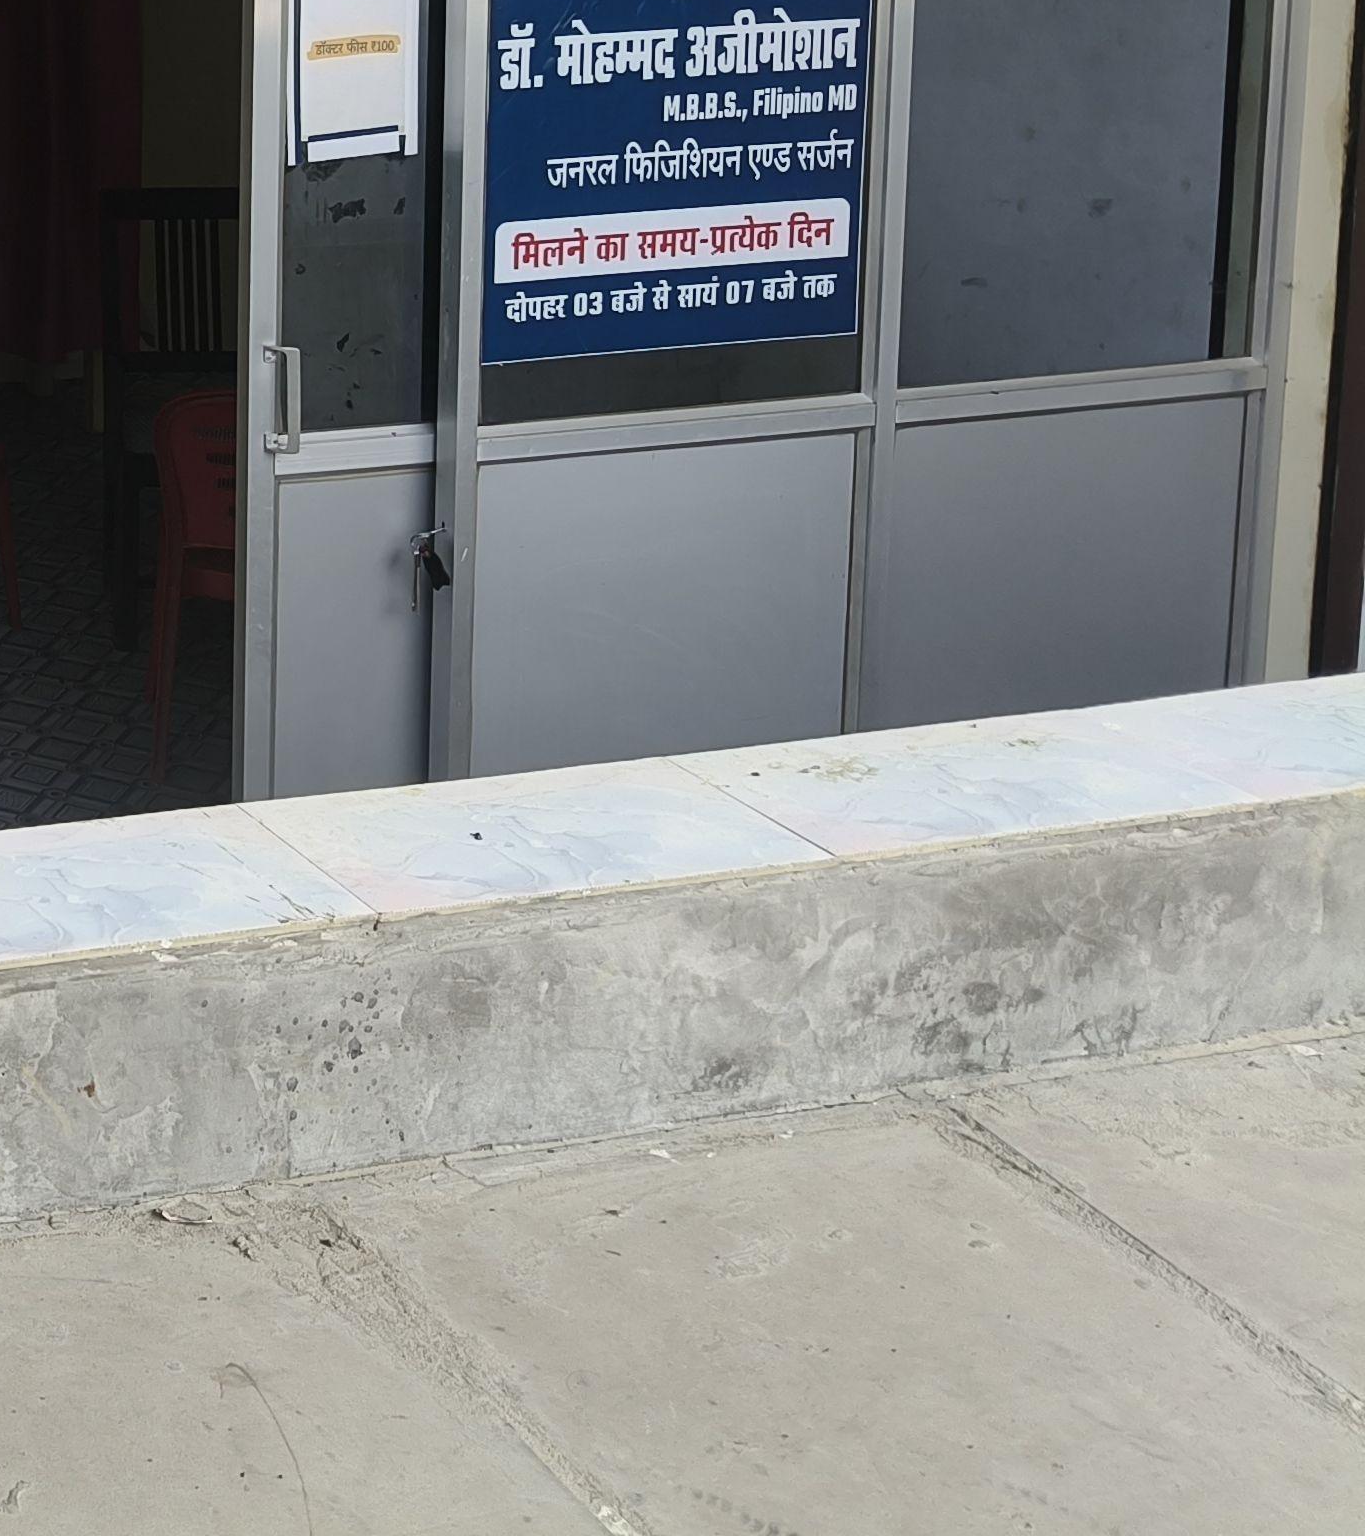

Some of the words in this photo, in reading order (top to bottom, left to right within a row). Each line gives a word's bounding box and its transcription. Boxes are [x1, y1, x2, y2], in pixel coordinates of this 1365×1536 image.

[315, 39, 344, 56] डॉक्टर
[347, 37, 368, 54] फीस
[371, 39, 395, 53] ₹100
[498, 22, 544, 90] डॉ.
[554, 19, 679, 85] मोहम्मद
[685, 7, 861, 77] अजीमोशान
[663, 91, 748, 122] M.B.B.S.,
[753, 87, 823, 119] Filipino
[828, 84, 858, 113] MD
[547, 154, 619, 189] जनरल
[624, 137, 744, 185] फिजिशियन
[748, 142, 793, 181] एण्ड
[797, 129, 855, 172] सर्जन
[512, 228, 588, 270] मिलने
[595, 233, 629, 262] का
[788, 212, 835, 249] दिन
[505, 292, 568, 323] दोपहर
[573, 292, 603, 317] 03
[610, 282, 647, 314] बजे
[651, 280, 671, 311] से
[677, 275, 719, 308] सायं
[725, 281, 754, 305] 07
[762, 270, 798, 302] बजे
[802, 274, 838, 299] तक
